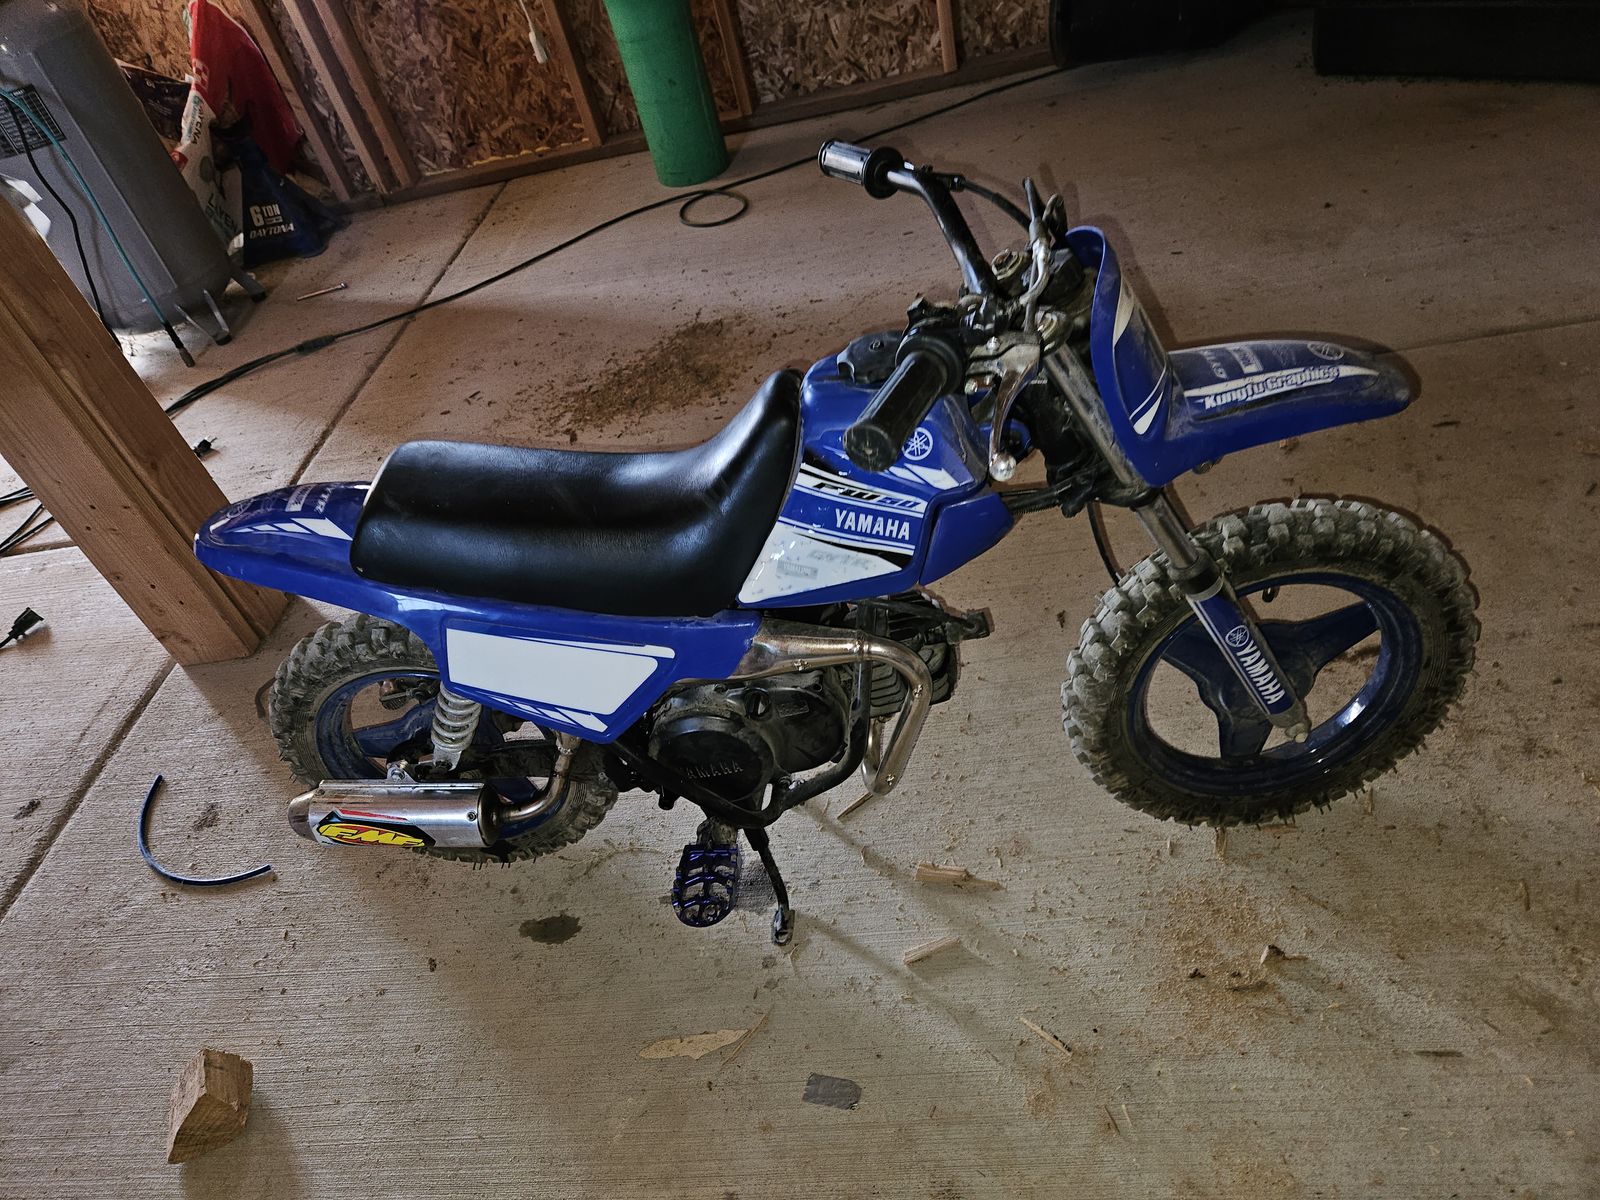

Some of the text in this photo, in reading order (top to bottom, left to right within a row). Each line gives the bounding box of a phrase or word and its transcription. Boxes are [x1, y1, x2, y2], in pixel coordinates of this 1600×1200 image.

[250, 205, 265, 227] 6
[261, 203, 280, 217] TON
[250, 223, 295, 239] DAYTONA
[835, 508, 911, 541] YAMAHA
[1236, 640, 1286, 705] YAMAHA
[681, 759, 744, 780] AMAHA
[319, 824, 426, 847] FMF
